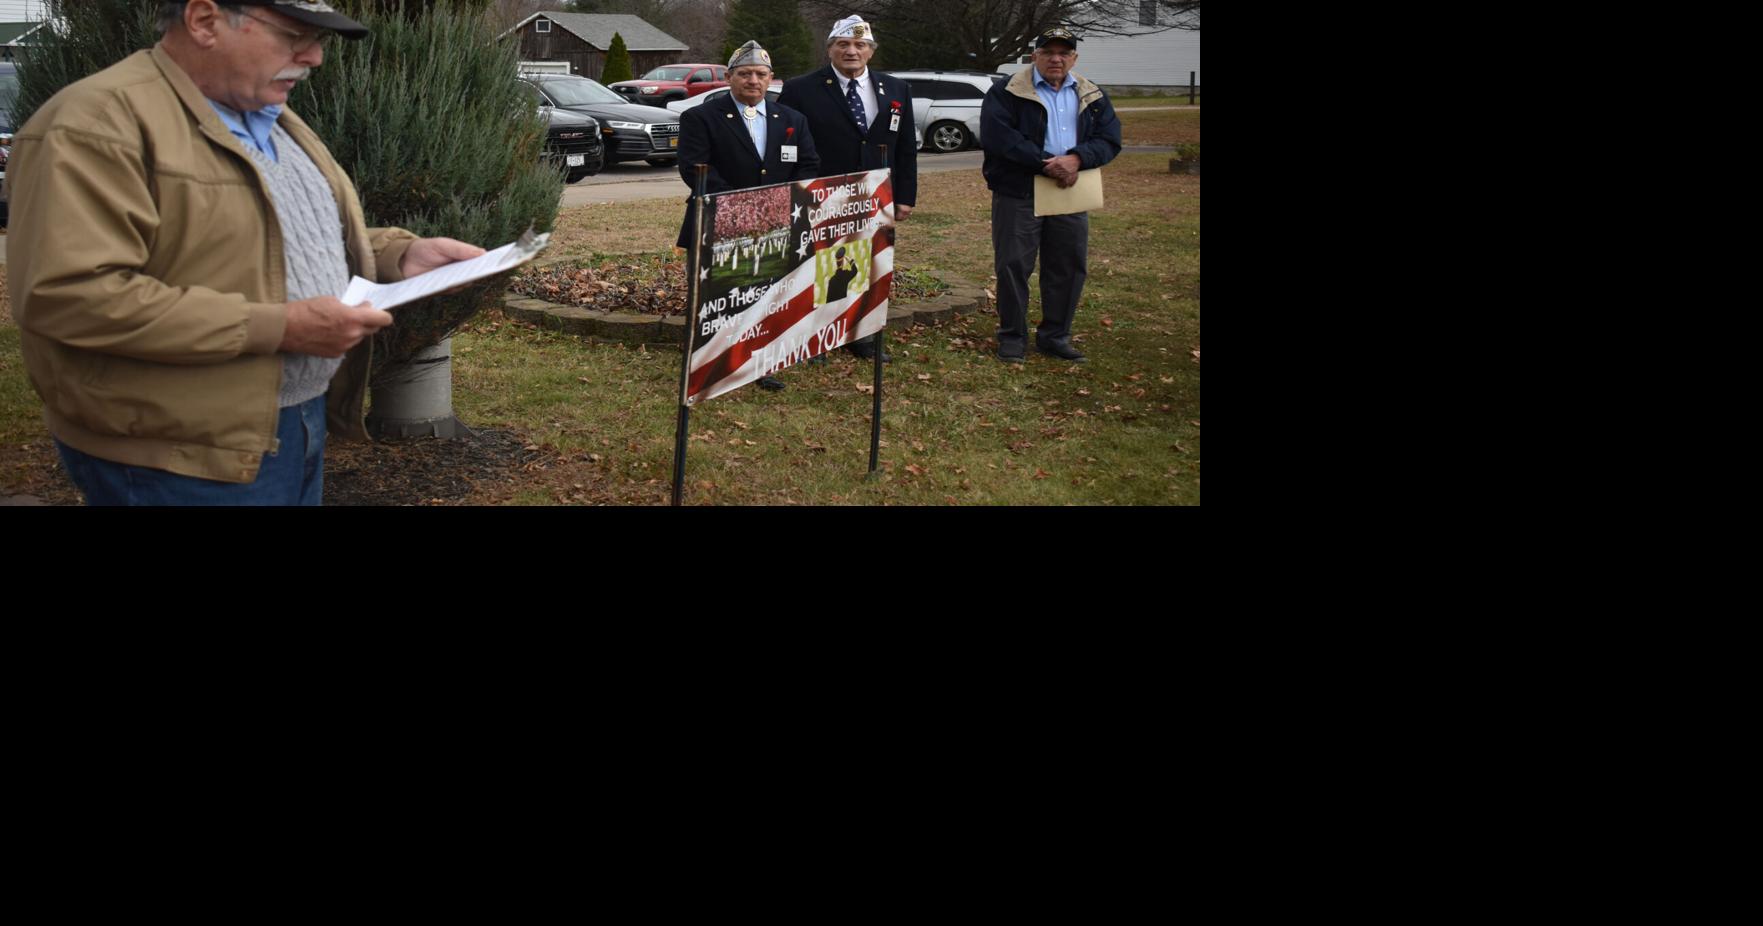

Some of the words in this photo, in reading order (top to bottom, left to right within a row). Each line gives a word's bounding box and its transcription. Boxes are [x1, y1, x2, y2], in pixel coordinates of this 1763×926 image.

[811, 189, 825, 203] TO
[826, 183, 857, 201] THOSE
[808, 198, 880, 223] COURAGEOUSLY
[800, 227, 827, 244] GAVE
[828, 220, 855, 239] THEIR
[699, 297, 726, 318] AND
[729, 285, 768, 308] THOSE
[751, 334, 811, 377] THANK
[816, 318, 848, 355] YOU
